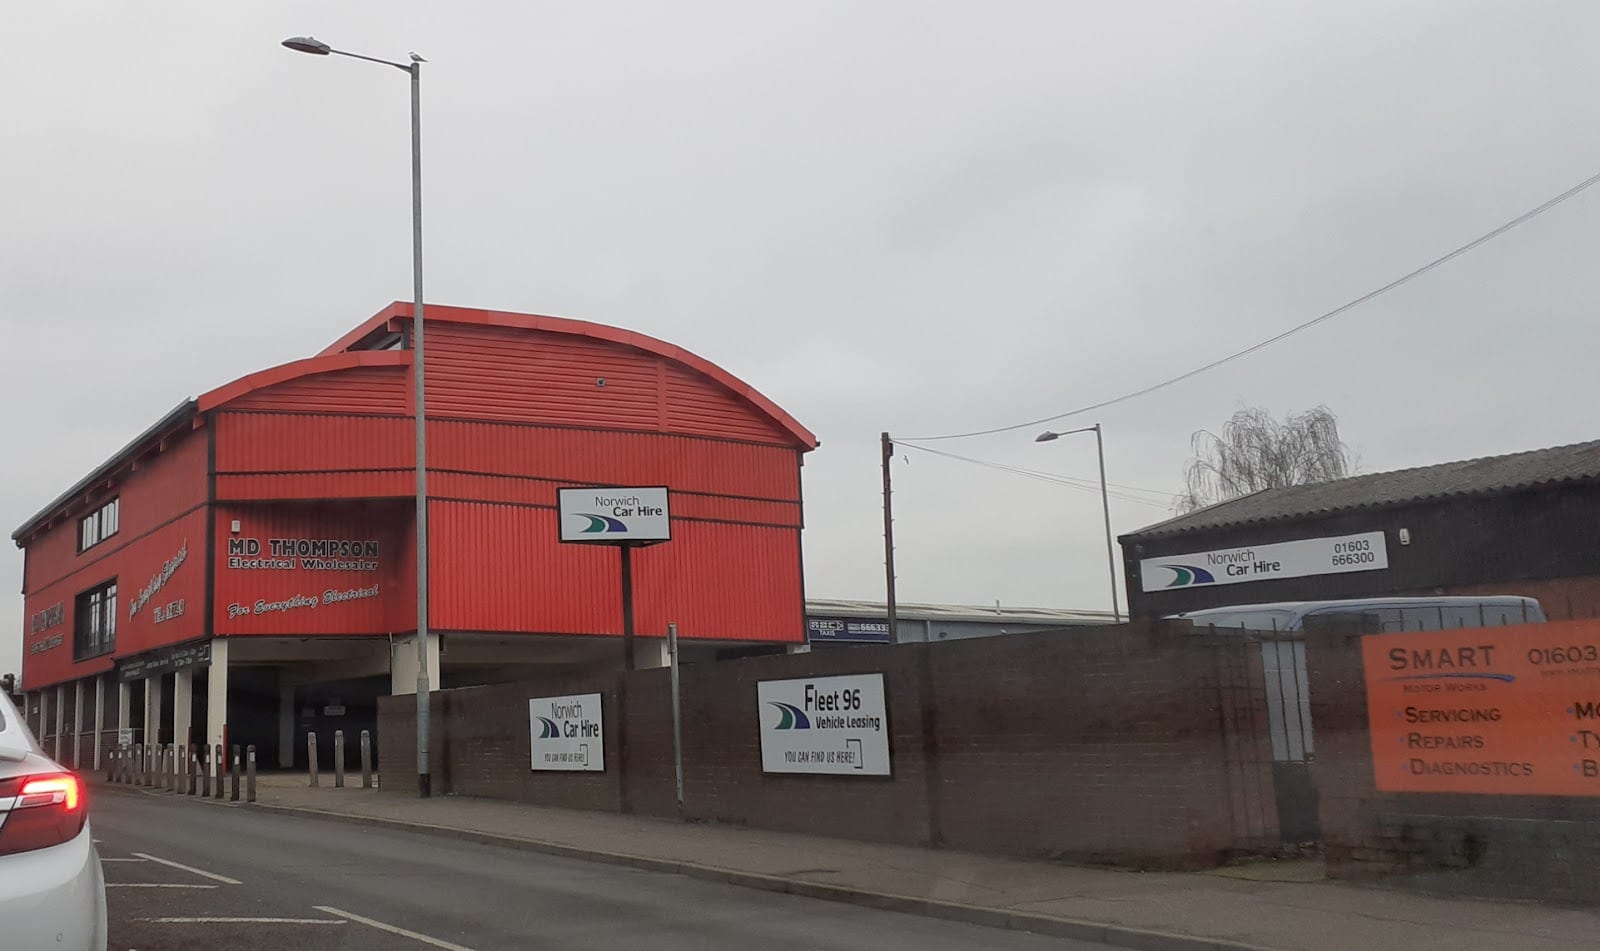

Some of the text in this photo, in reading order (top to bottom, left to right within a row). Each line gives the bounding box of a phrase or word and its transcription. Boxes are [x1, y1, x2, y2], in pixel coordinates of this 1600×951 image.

[595, 496, 640, 507] Norwich
[613, 505, 663, 517] Car Hire
[228, 537, 379, 558] MD THOMPSON
[1334, 540, 1370, 554] 01603
[228, 557, 379, 571] Electrical Wholesaler
[1207, 550, 1256, 566] Norwich
[1332, 552, 1375, 566] 666300
[1226, 560, 1281, 577] Car Hire
[228, 584, 379, 619] For Everything Electrical
[1389, 645, 1495, 671] SMART
[1527, 645, 1598, 665] 01603
[1403, 683, 1487, 693] MOTOR WORKS
[804, 684, 861, 712] Fleet 96
[551, 700, 583, 719] Norwich
[1405, 706, 1501, 723] SERVICING
[563, 719, 599, 738] Car Hire
[816, 714, 880, 731] Vehicle Leasing
[1407, 732, 1485, 749] REPAIRS
[784, 751, 855, 763] YOU CAN FIND US HERE!
[1410, 758, 1534, 776] DIAGNOSTICS
